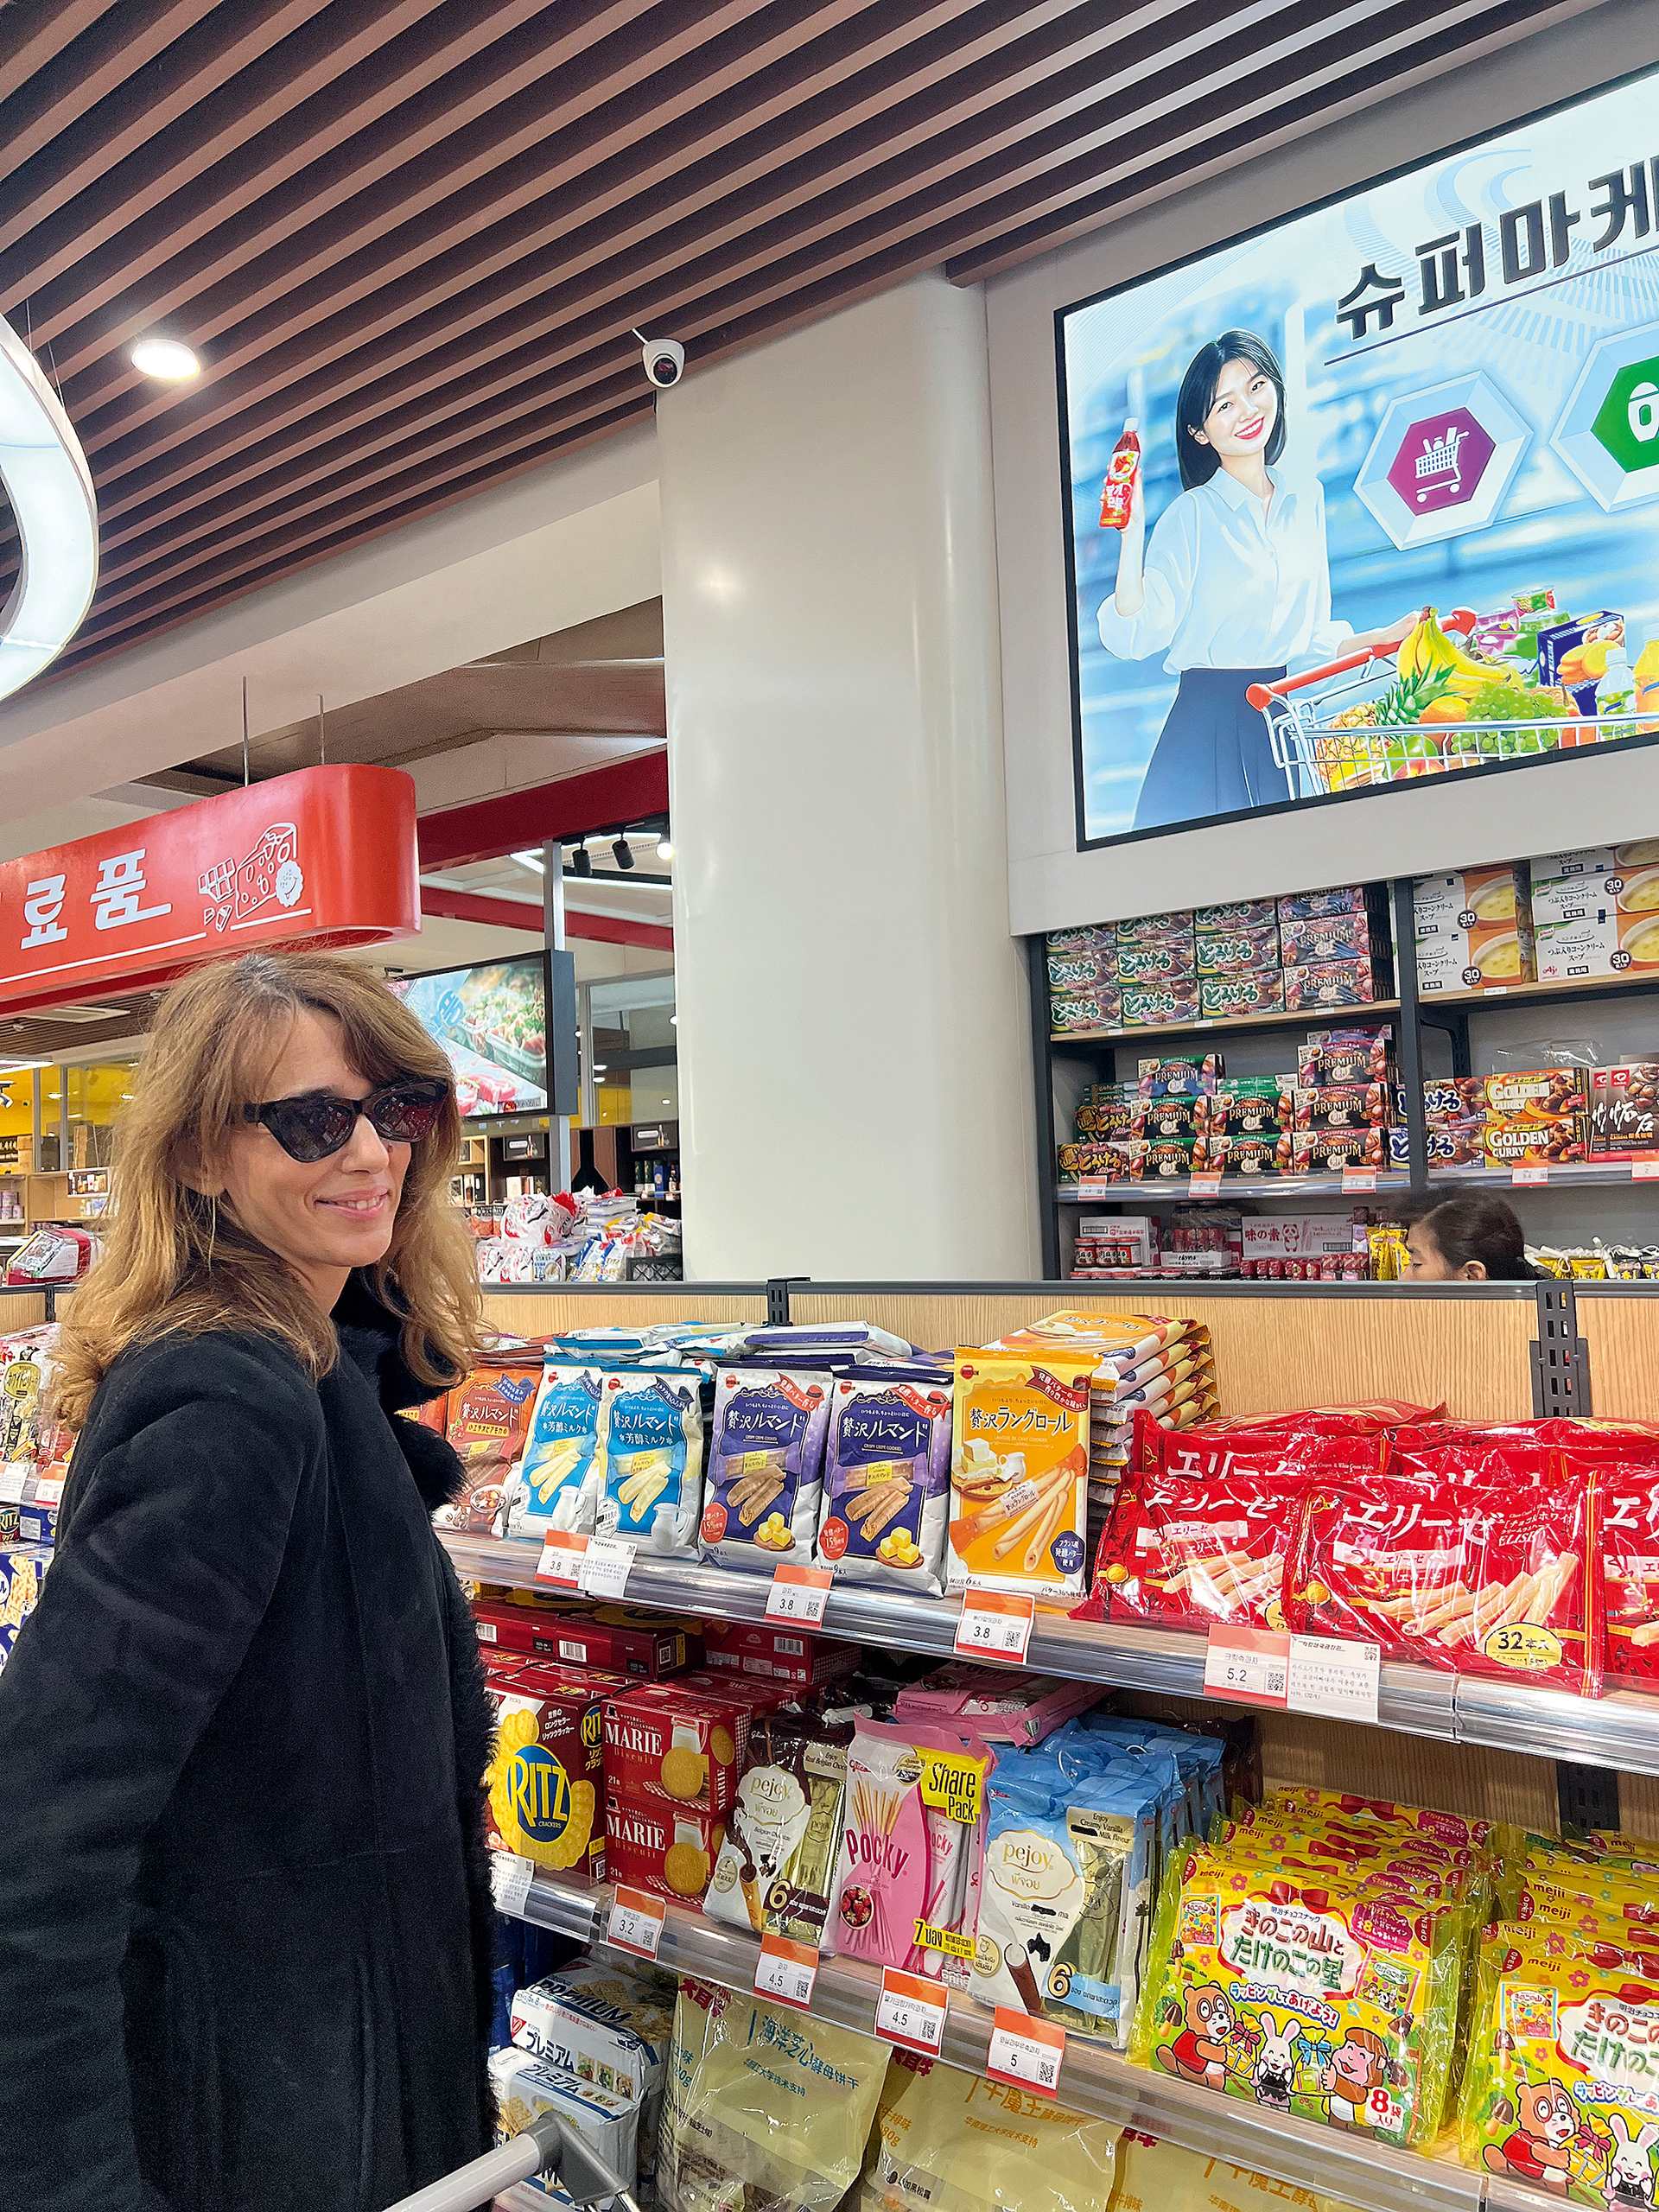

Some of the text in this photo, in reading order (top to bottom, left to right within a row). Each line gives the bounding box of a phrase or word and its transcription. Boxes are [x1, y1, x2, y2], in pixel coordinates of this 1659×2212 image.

[1606, 880, 1622, 889] 30
[1548, 892, 1598, 904] つぶ入りコーンクリーム
[1459, 912, 1476, 923] 30
[1300, 931, 1350, 944] PREMIUM
[1198, 937, 1253, 966] とろける
[1548, 943, 1605, 956] つぶ入りコーンクリーム
[1568, 953, 1585, 962] スープ
[1612, 953, 1630, 964] 30
[1464, 969, 1480, 979] 30
[1304, 976, 1353, 991] PREMIUM
[1202, 982, 1259, 1008] とろける
[1123, 992, 1176, 1018] とろける
[1318, 1056, 1366, 1071] PREMIUM
[1155, 1070, 1198, 1084] PREMIUM
[1490, 1082, 1550, 1100] GOLDEN
[1230, 1107, 1274, 1121] PREMIUM
[1314, 1100, 1362, 1116] PREMIUM
[1147, 1112, 1190, 1124] PREMIUM
[1489, 1129, 1549, 1147] GOLDEN
[1227, 1150, 1273, 1163] PREMIUM
[1313, 1145, 1362, 1160] PREMIUM
[1492, 1146, 1525, 1158] CURRY
[1079, 1152, 1121, 1171] とろける
[1147, 1154, 1189, 1166] PREMIUM
[1245, 1229, 1280, 1242] 味の素
[1039, 1372, 1073, 1399] 発酵バターの
[461, 1402, 518, 1427] 贅沢ルマンド
[540, 1400, 595, 1425] 贅沢ルマンド
[548, 1421, 583, 1434] 芳醇ミルク
[613, 1409, 678, 1436] 贅沢ルマンド
[728, 1410, 805, 1438] 贅沢ルマンド
[969, 1406, 1074, 1436] 贅沢ラングロール
[473, 1424, 504, 1435] エチオピアモカ
[842, 1417, 929, 1447] 贅沢ルマンド
[626, 1433, 665, 1446] 芳醇ミルク
[1344, 1501, 1504, 1545] エリーゼ
[1058, 1540, 1079, 1548] フランス産
[1055, 1548, 1083, 1559] 発酵バター
[1383, 1553, 1426, 1564] エリーゼ
[550, 1560, 562, 1571] 3.8
[1062, 1559, 1074, 1567] 使用
[779, 1599, 794, 1610] 3.8
[974, 1625, 990, 1638] 3.8
[1497, 1631, 1549, 1650] 32本入
[1226, 1668, 1247, 1682] 5.2
[548, 1708, 562, 1719] 世界の
[544, 1717, 571, 1730] ロングセラー
[542, 1726, 575, 1740] リッツクラッカー
[605, 1722, 663, 1756] MARIE
[613, 1747, 654, 1764] Biscuit
[929, 1762, 976, 1798] Share
[508, 1755, 569, 1827] RITZ
[717, 1767, 727, 1810] MARIE
[749, 1776, 792, 1801] pejoy
[948, 1796, 976, 1821] Pack
[1298, 1805, 1324, 1818] meiji
[1093, 1813, 1109, 1822] Enjoy
[1257, 1815, 1284, 1828] meiji
[607, 1814, 665, 1851] MARIE
[1080, 1819, 1123, 1834] Creamy Vanilla
[1238, 1827, 1265, 1839] meiji
[1099, 1831, 1130, 1844] Milk flavour
[615, 1838, 656, 1859] Biscuit
[846, 1828, 910, 1879] Pocky
[1003, 1842, 1053, 1867] pejoy
[769, 1878, 792, 1908] 6
[1534, 1883, 1565, 1897] meiji
[1011, 1900, 1031, 1910] Vanilla
[1186, 1902, 1210, 1914] きのこの山
[1539, 1903, 1571, 1918] meiji
[1270, 1905, 1321, 1923] 明治チョコスナック
[620, 1919, 635, 1935] 3.2
[916, 1920, 925, 1942] 7
[1242, 1908, 1344, 1955] きのこの山と
[1503, 1924, 1536, 1938] meiji
[1230, 1935, 1344, 1990] たけのこの里
[1505, 1951, 1517, 1970] OPEN
[1528, 1958, 1561, 1972] meiji
[769, 1974, 784, 1986] 4.5
[1048, 1962, 1072, 1999] 6
[1514, 1993, 1542, 2004] きのこの山
[1230, 1983, 1339, 2029] ラッピングしてあげよう!
[892, 2012, 908, 2025] 4.5
[526, 2031, 575, 2074] プレミアム
[1010, 2054, 1018, 2067] 5
[524, 2063, 583, 2094] プレミアム
